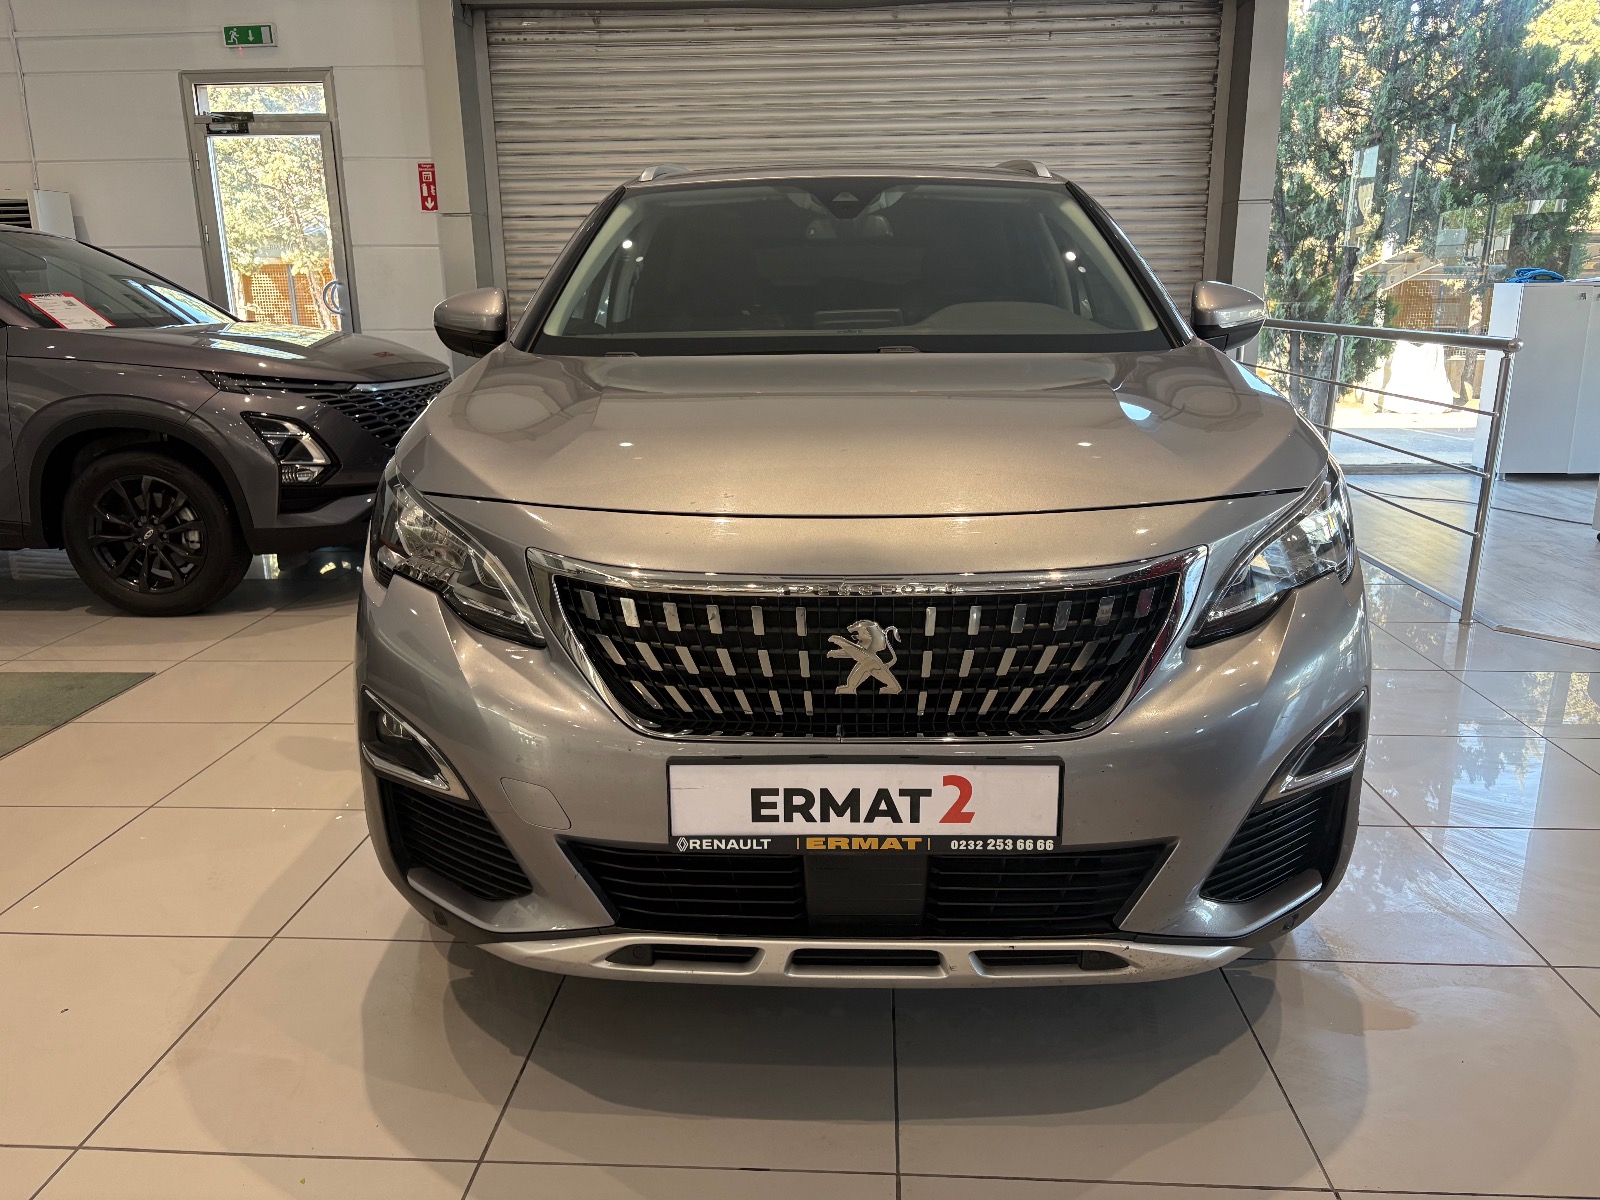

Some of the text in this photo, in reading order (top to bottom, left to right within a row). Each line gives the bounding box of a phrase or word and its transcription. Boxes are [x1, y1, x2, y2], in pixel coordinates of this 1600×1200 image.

[750, 774, 976, 824] ERMAT 2
[689, 838, 772, 850] RENAULT
[806, 837, 922, 850] ERMAT
[950, 839, 1054, 851] 0232 253 66 66
